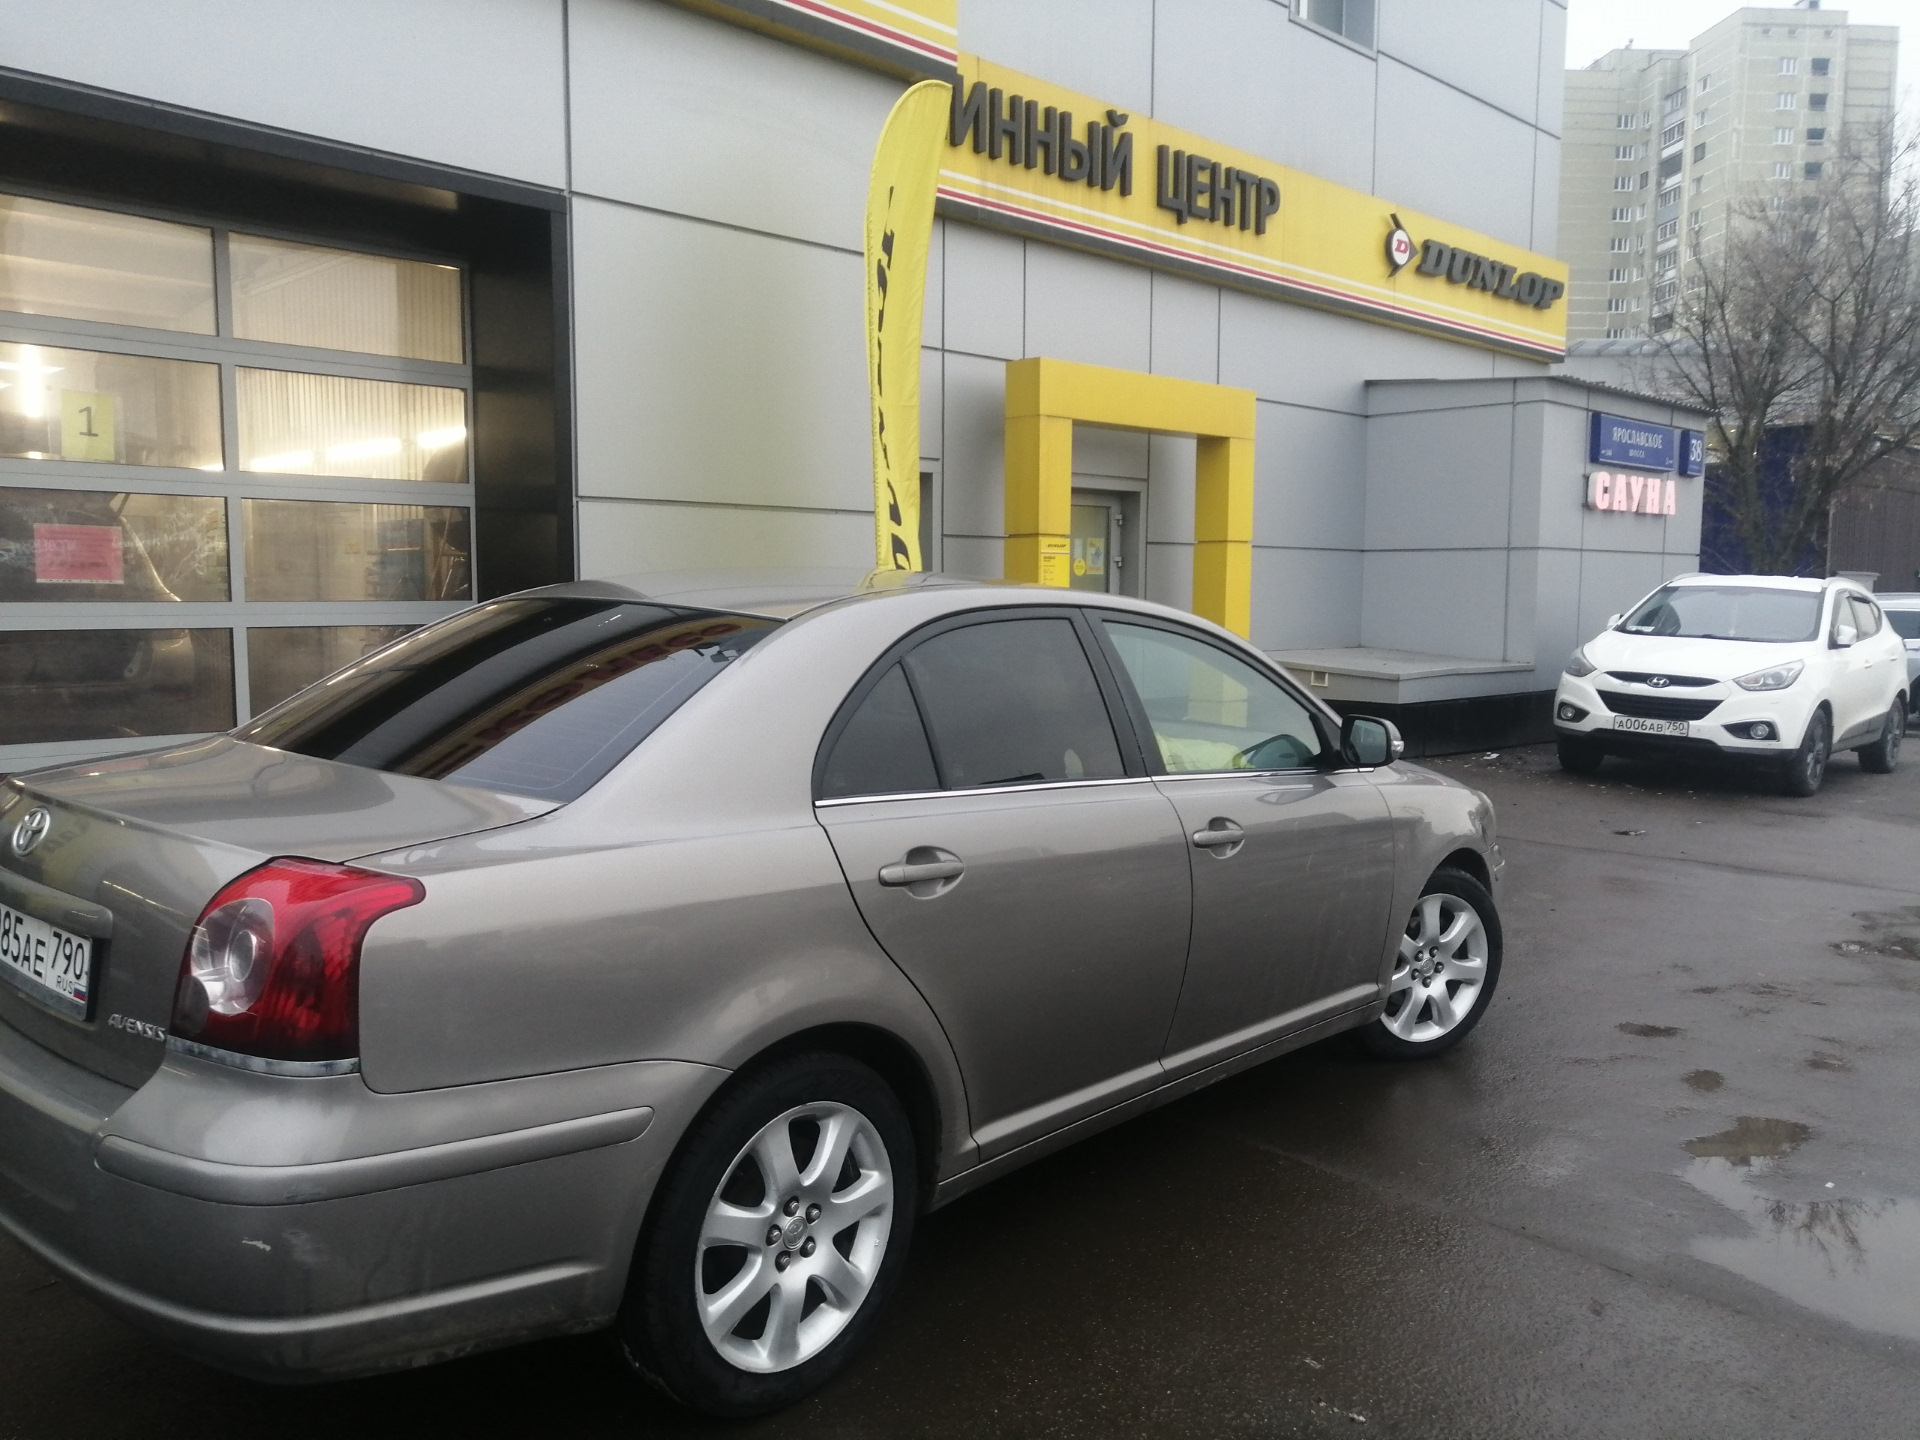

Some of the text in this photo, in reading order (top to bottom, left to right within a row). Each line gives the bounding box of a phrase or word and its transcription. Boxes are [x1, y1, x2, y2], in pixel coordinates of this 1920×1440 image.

[946, 76, 1281, 236] ИННЫЙ ЦЕНТР
[1415, 239, 1565, 309] DUNLOP
[78, 406, 98, 437] 1
[1613, 427, 1663, 449] ЯРОСЛАВСКОЕ
[1690, 439, 1703, 462] 38
[1594, 471, 1676, 515] САУНА
[0, 905, 46, 979] 85АЕ
[56, 975, 73, 995] RUS
[108, 1013, 166, 1042] AVENSIS
